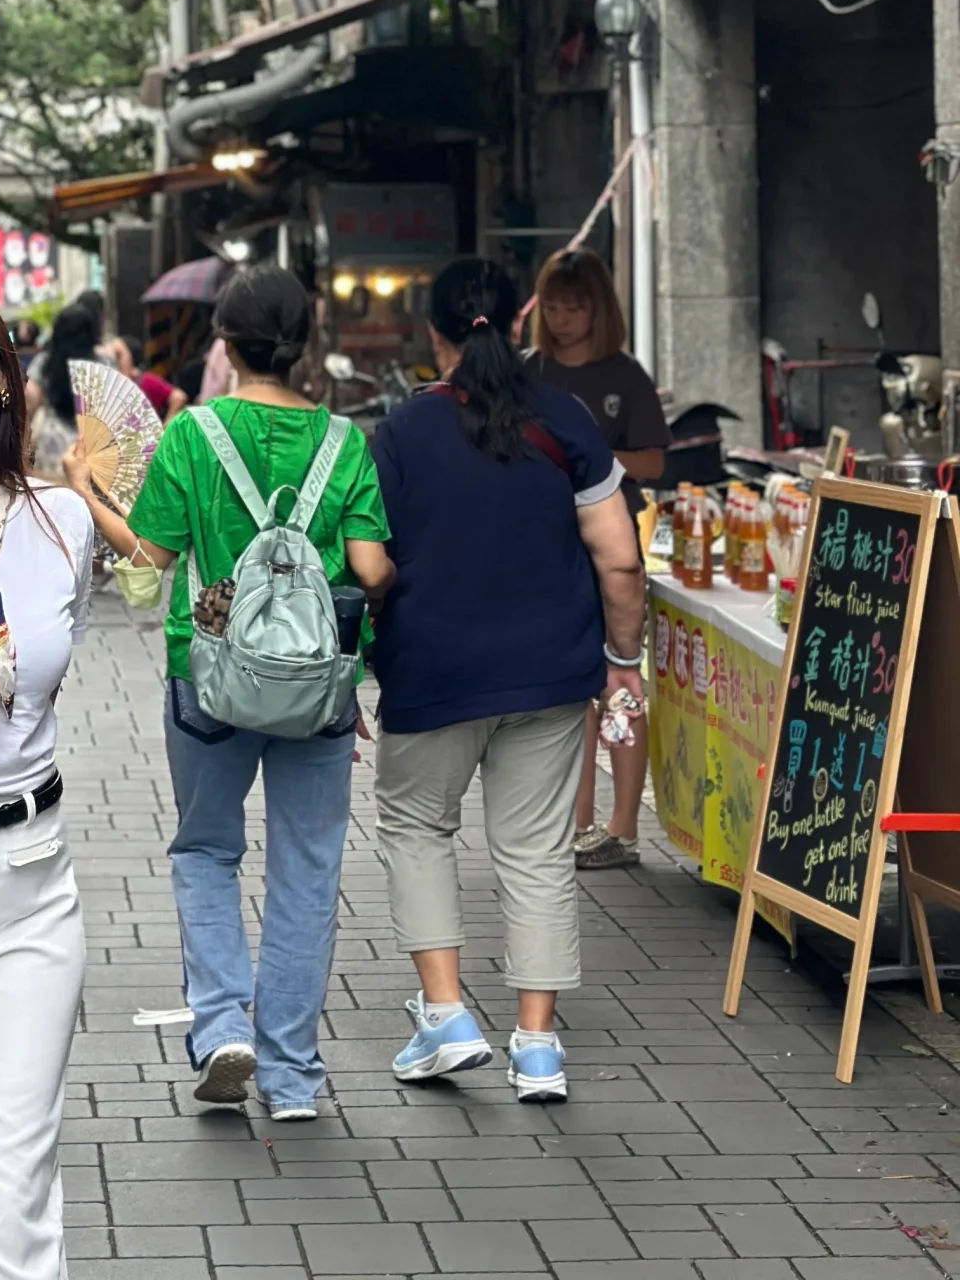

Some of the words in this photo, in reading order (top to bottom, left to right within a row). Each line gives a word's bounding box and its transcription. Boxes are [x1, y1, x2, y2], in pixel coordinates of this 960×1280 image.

[820, 508, 893, 582] 楊桃汁
[892, 529, 916, 585] 30
[847, 581, 873, 616] fruit
[874, 599, 900, 624] juice
[804, 626, 871, 699] 金桔汁
[872, 645, 898, 695] 30
[804, 681, 850, 726] Kumquat
[852, 706, 876, 733] juice
[767, 810, 790, 851] Buy
[792, 817, 814, 837] one
[814, 796, 846, 829] bottle
[802, 839, 825, 887] get
[828, 836, 848, 862] one
[850, 813, 870, 861] free
[825, 865, 858, 904] drink
